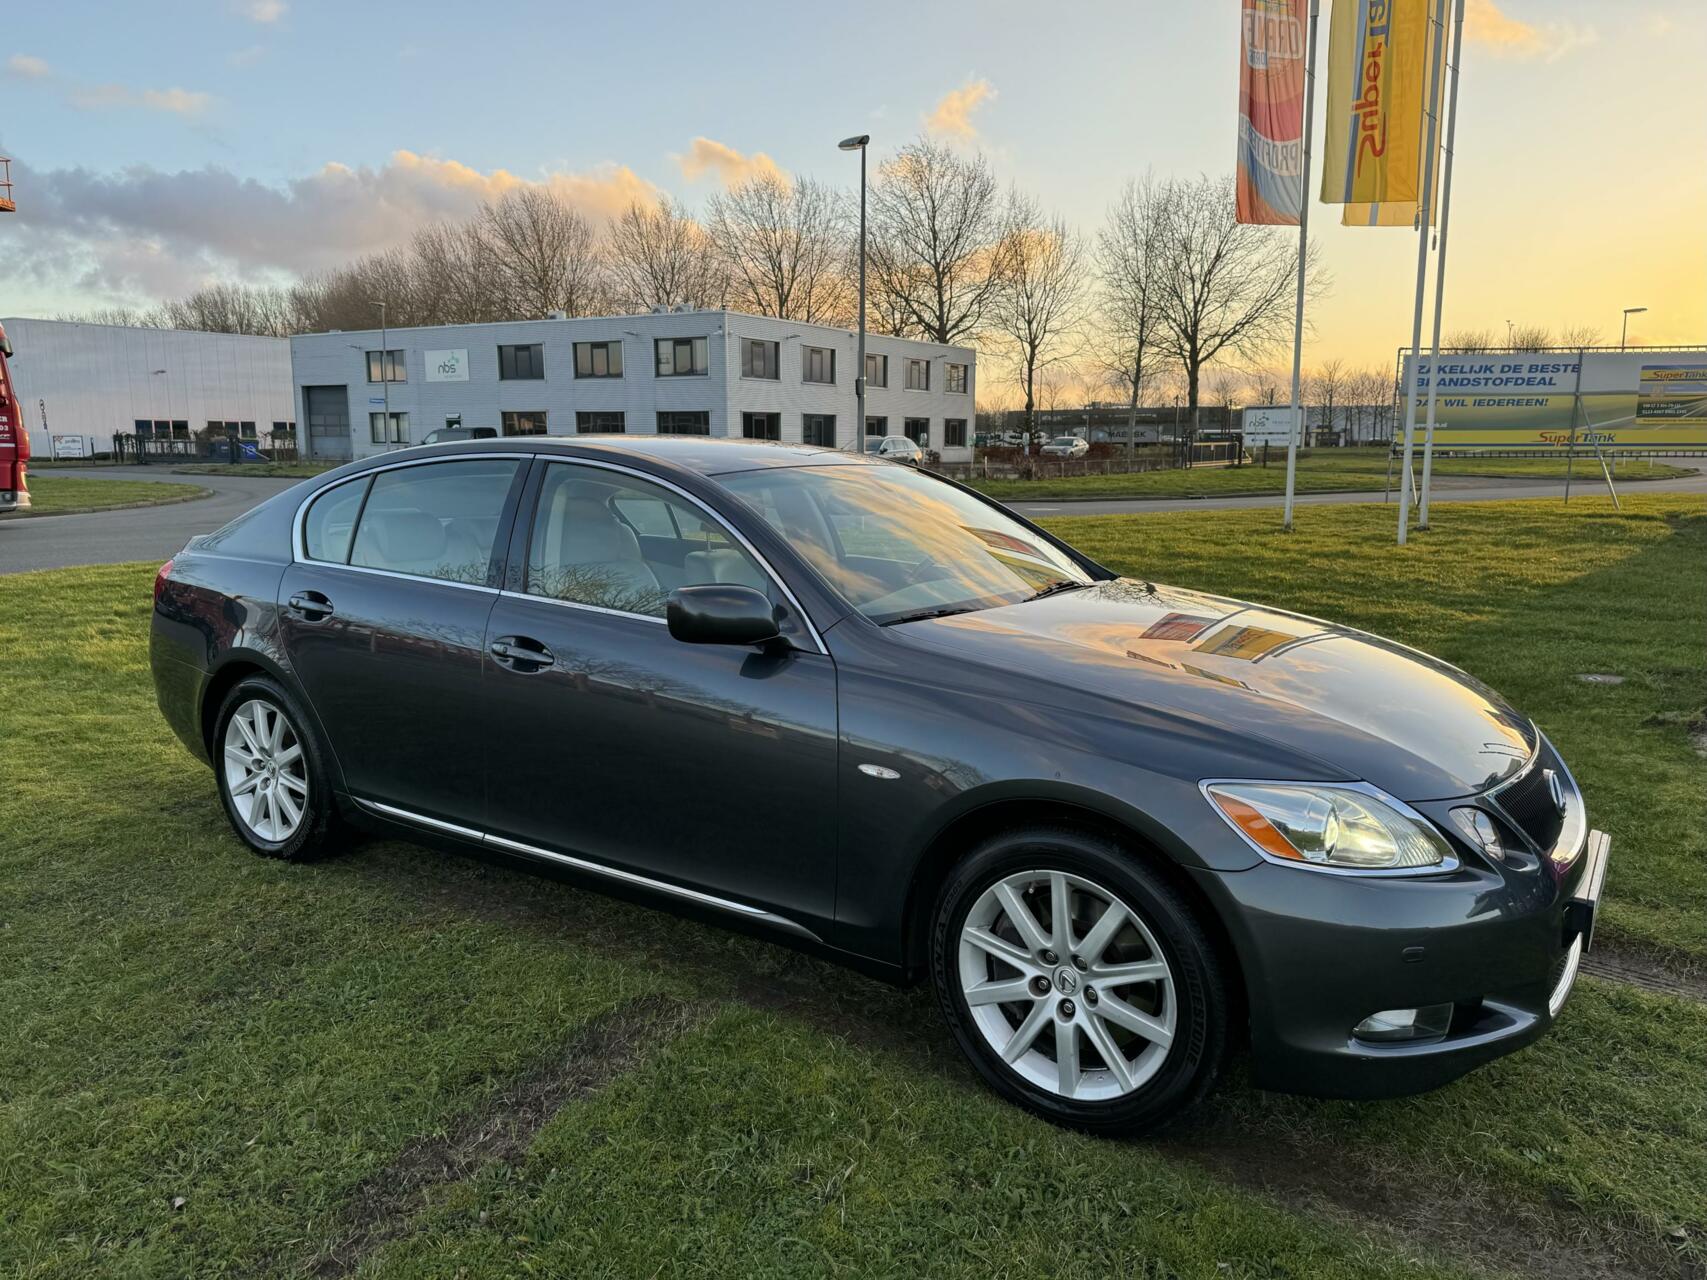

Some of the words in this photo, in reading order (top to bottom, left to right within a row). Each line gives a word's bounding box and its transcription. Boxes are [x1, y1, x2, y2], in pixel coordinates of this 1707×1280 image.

[437, 361, 456, 374] nbs
[1500, 364, 1524, 374] DE
[1528, 363, 1581, 374] BESTE
[1443, 399, 1469, 408] WIL
[1472, 398, 1549, 408] IEDEREEN!
